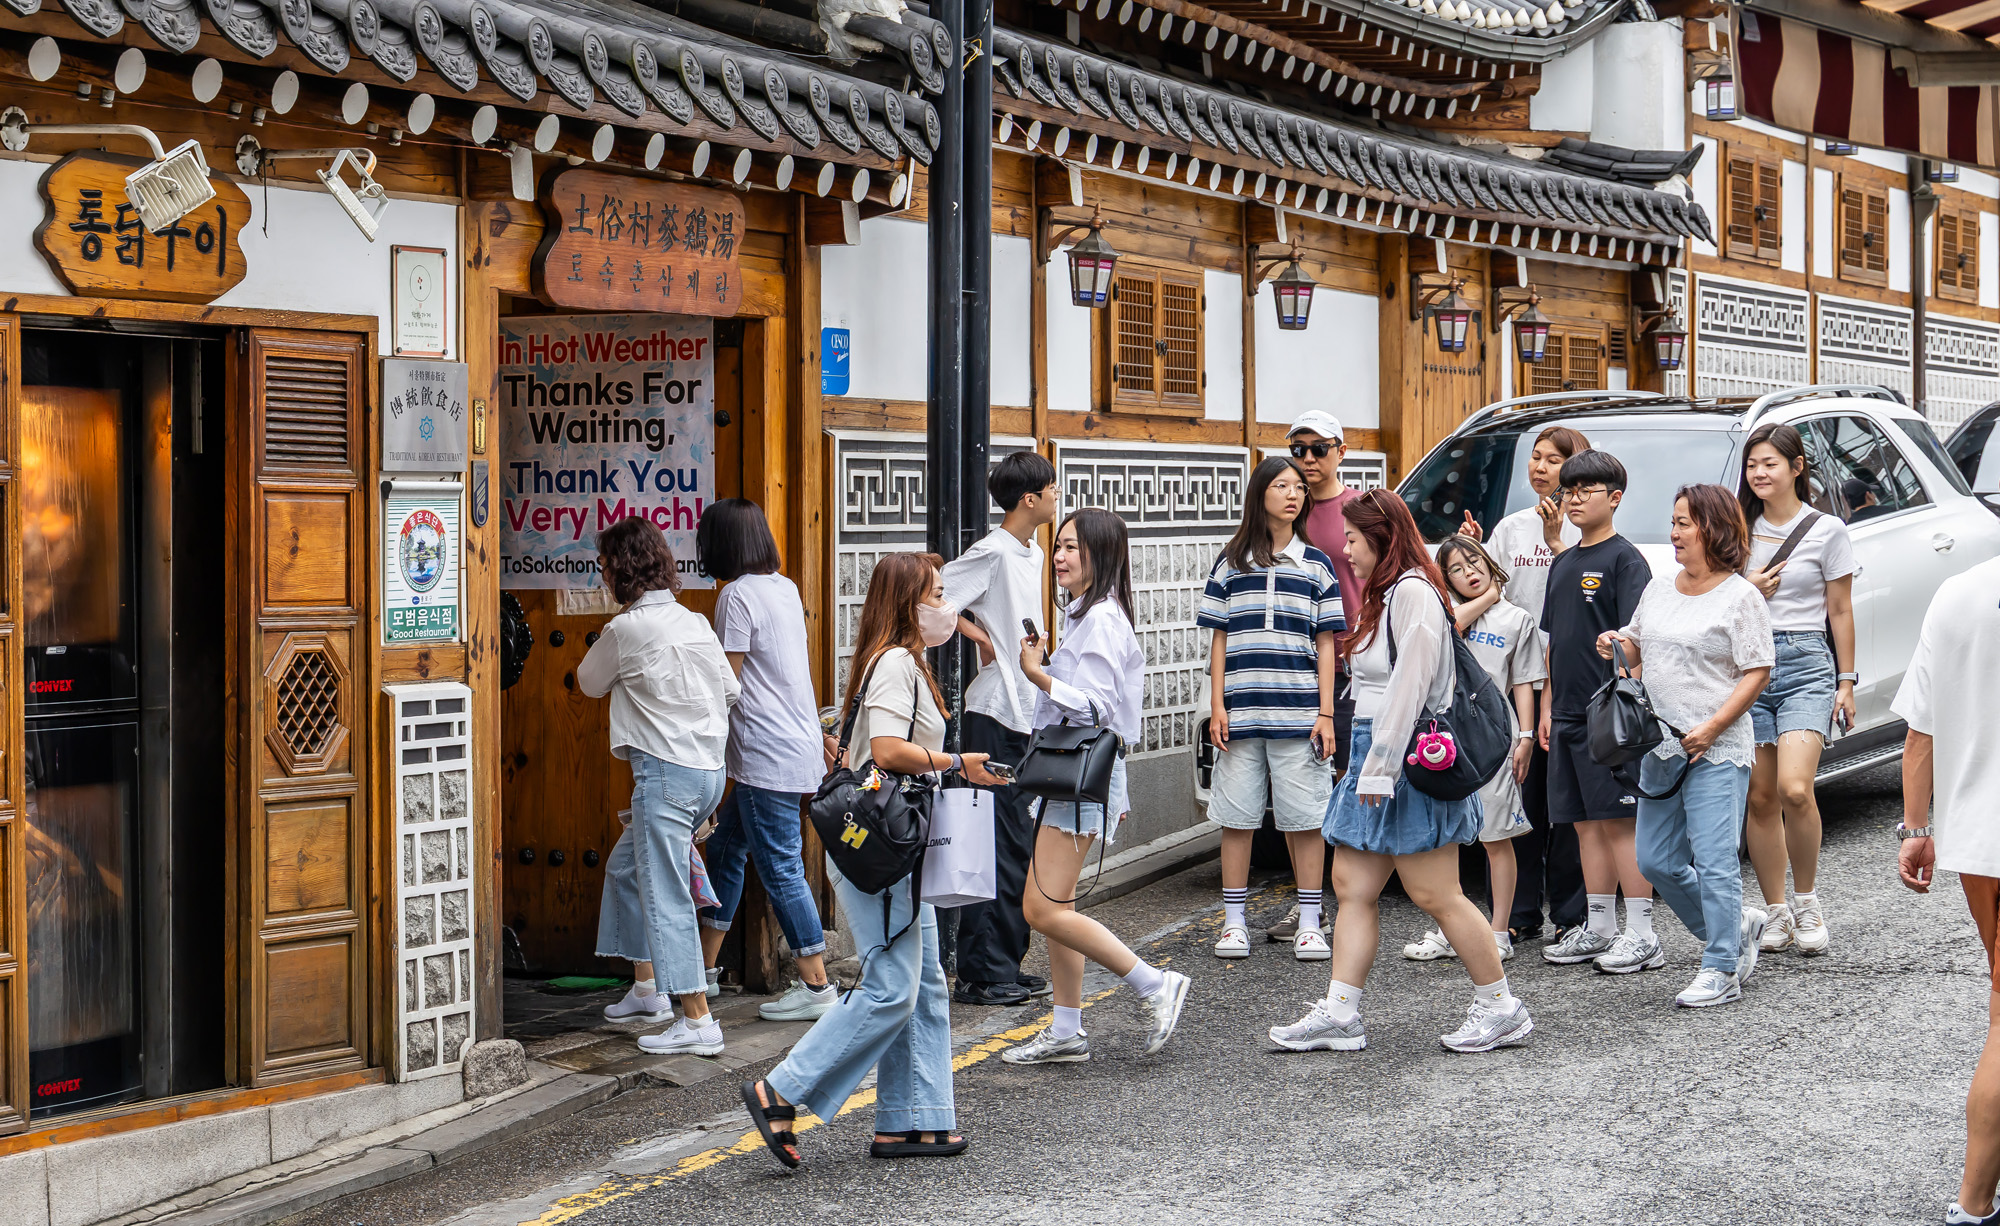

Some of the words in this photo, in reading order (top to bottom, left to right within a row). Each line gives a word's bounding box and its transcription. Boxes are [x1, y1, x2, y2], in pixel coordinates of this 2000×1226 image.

[499, 335, 522, 365] In
[528, 333, 580, 365] Hot
[584, 330, 708, 363] Weather
[503, 372, 634, 408] Thanks
[643, 371, 703, 405] For
[528, 409, 676, 451] Waiting,
[389, 451, 417, 461] TRADITIONAL
[418, 452, 436, 462] KOREAN
[436, 452, 463, 462] RESTAURANT
[509, 461, 620, 496] Thank
[626, 459, 698, 494] You
[505, 498, 589, 541] Very
[1514, 554, 1534, 568] the
[1535, 557, 1555, 567] ne
[392, 607, 452, 627] 모범음식점
[392, 629, 413, 639] Good
[414, 626, 451, 639] Restaurant
[1468, 629, 1506, 649] GERS
[29, 679, 73, 693] CONVEX
[841, 822, 869, 849] H
[926, 837, 952, 848] LOMON
[37, 1078, 81, 1097] CONVEX
